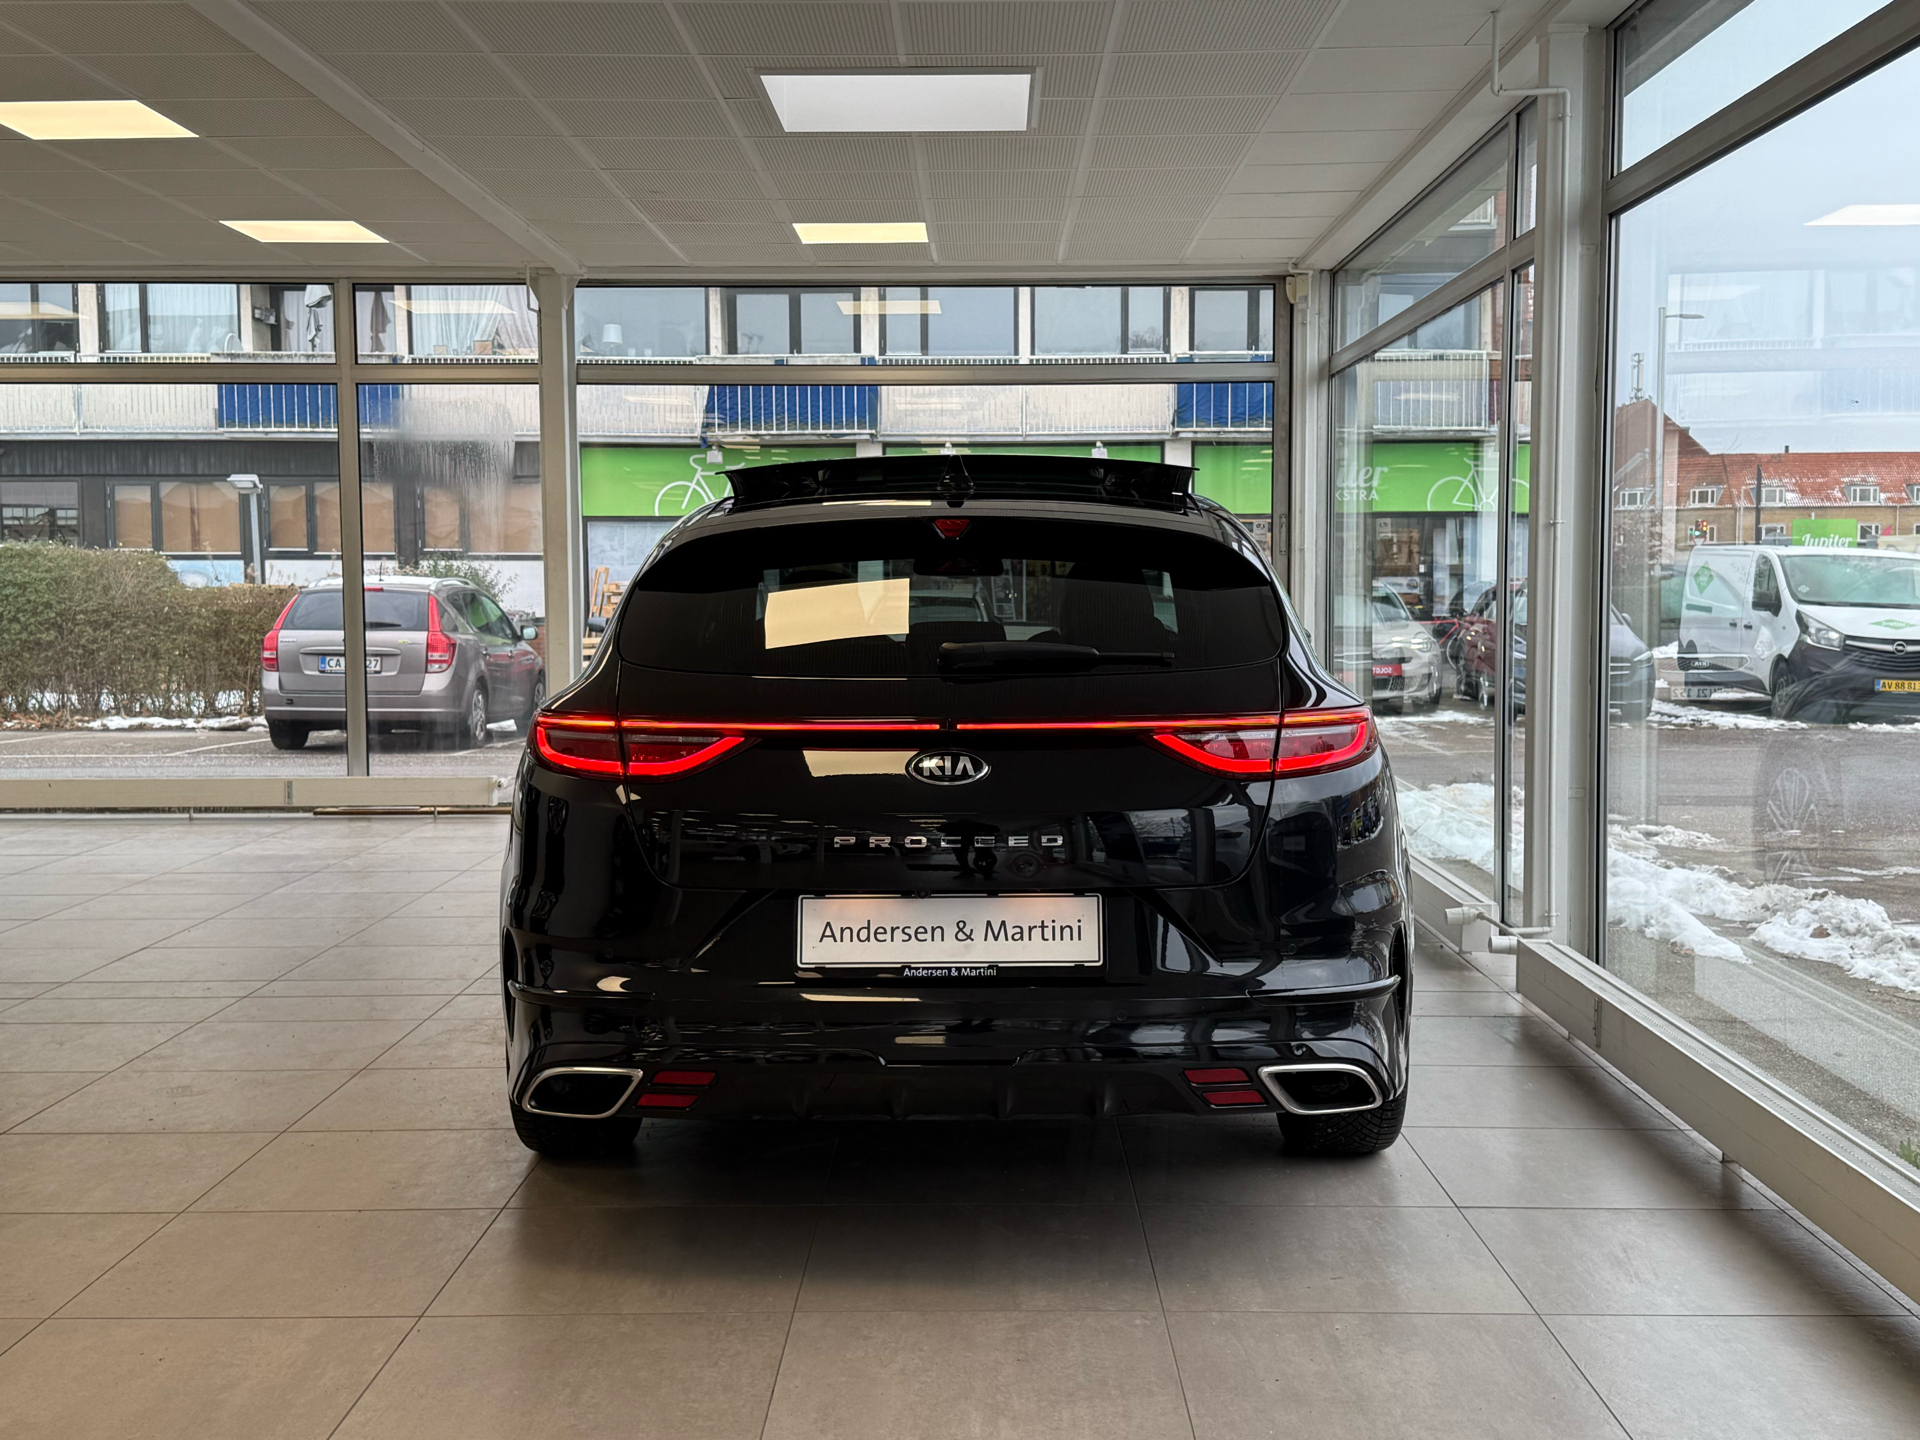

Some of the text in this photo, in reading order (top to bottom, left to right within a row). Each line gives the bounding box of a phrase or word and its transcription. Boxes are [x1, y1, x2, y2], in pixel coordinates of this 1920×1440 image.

[327, 658, 342, 669] CA
[1881, 681, 1893, 690] AV
[1894, 682, 1906, 690] 88
[923, 756, 976, 776] KIA
[834, 836, 1064, 847] PROCEED
[819, 919, 1083, 943] Andersen & Martini
[903, 966, 997, 977] Andersen & Martini
